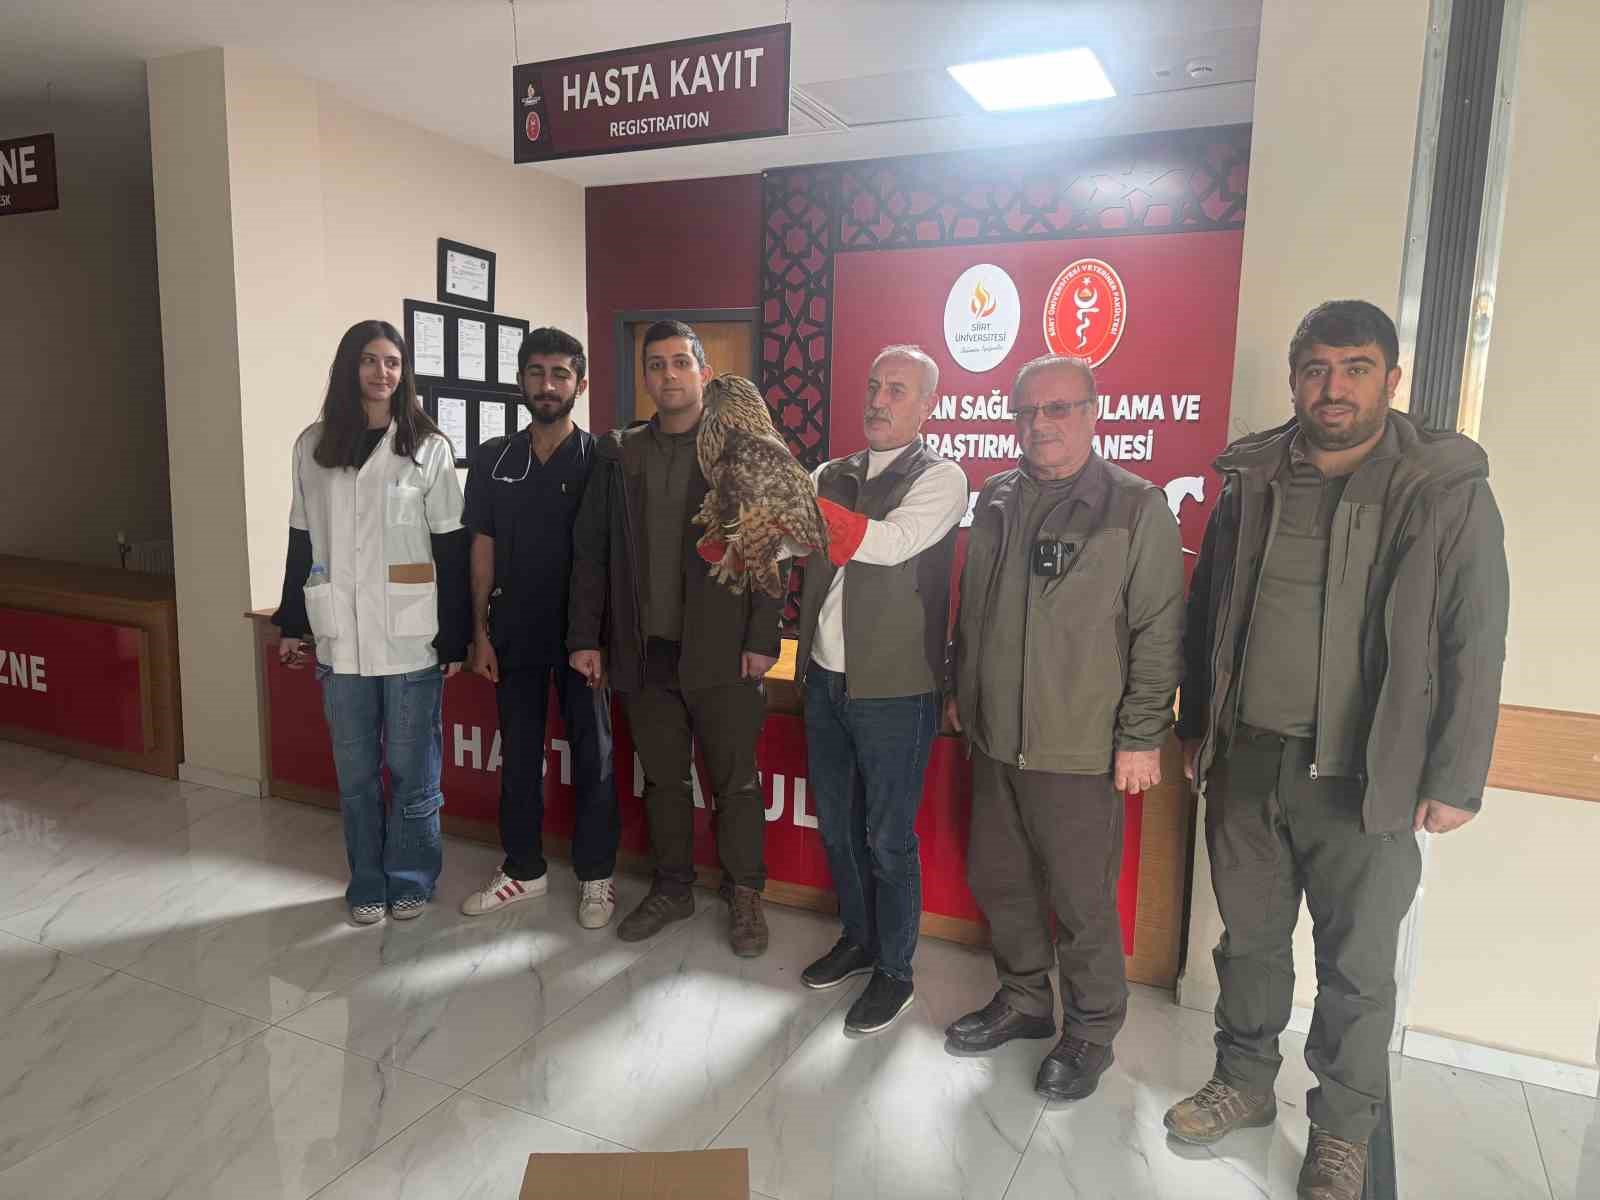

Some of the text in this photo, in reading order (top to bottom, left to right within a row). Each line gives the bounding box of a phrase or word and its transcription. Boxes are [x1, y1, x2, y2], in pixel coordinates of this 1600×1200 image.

[562, 48, 764, 111] HASTA KAYIT
[610, 112, 710, 137] REGISTRATION
[960, 389, 1017, 420] SAĞL
[1171, 394, 1200, 420] VE
[1091, 429, 1153, 460] ANESİ
